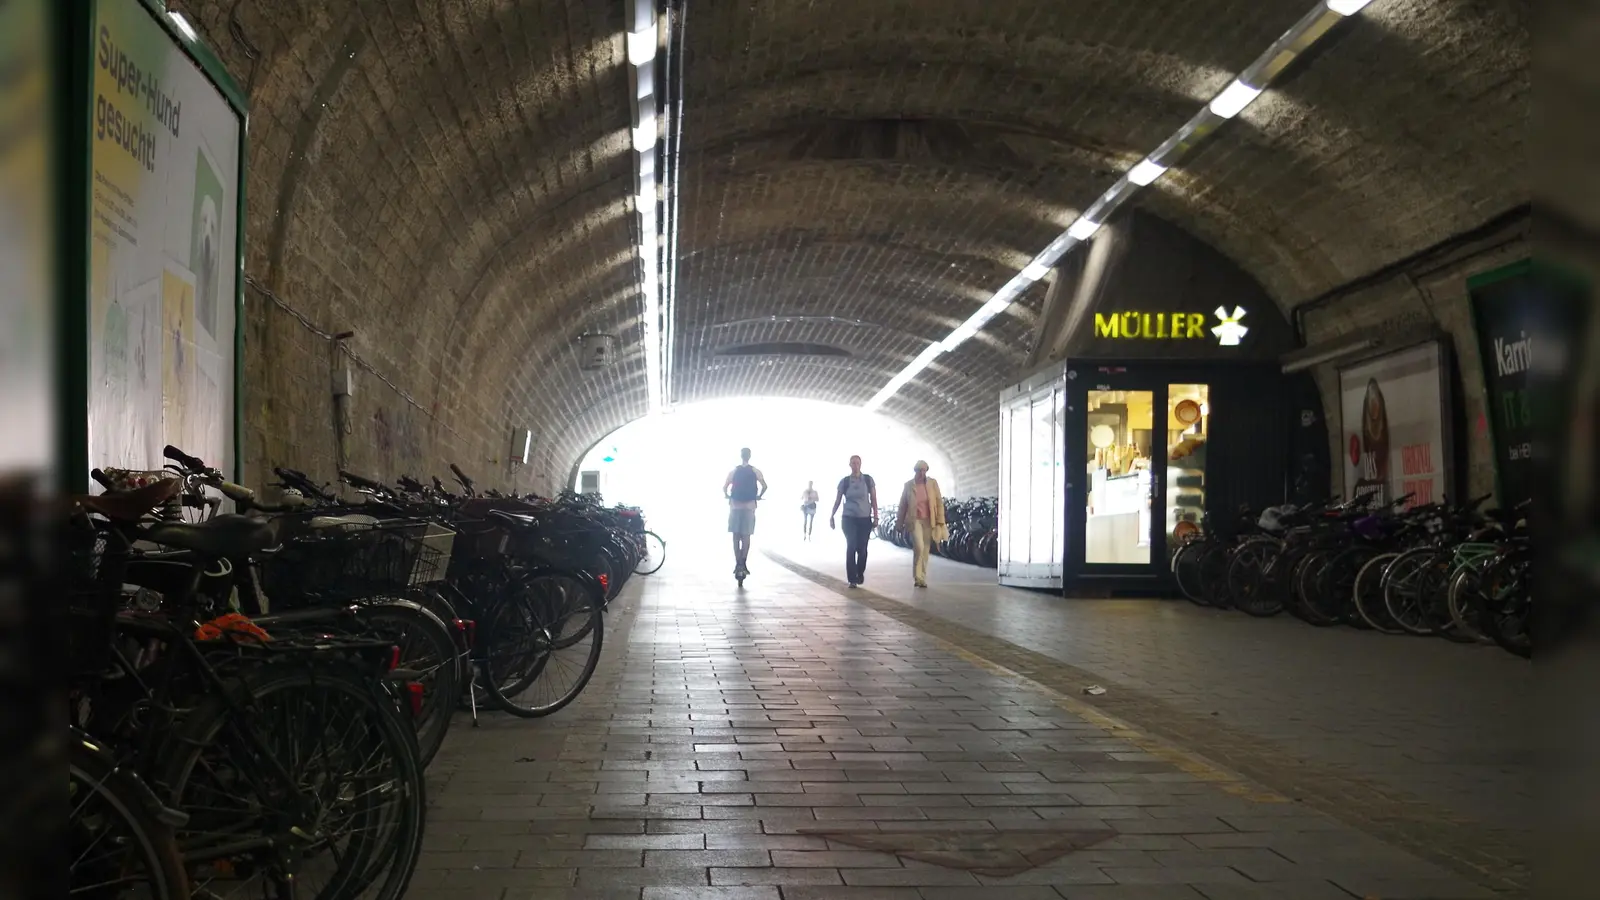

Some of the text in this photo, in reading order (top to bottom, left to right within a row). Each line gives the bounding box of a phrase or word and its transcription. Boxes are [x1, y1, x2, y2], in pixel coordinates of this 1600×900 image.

[98, 25, 182, 138] Super-Hund
[97, 93, 156, 173] gesucht!
[1094, 311, 1205, 338] MÜLLER
[1364, 450, 1377, 481] DAS
